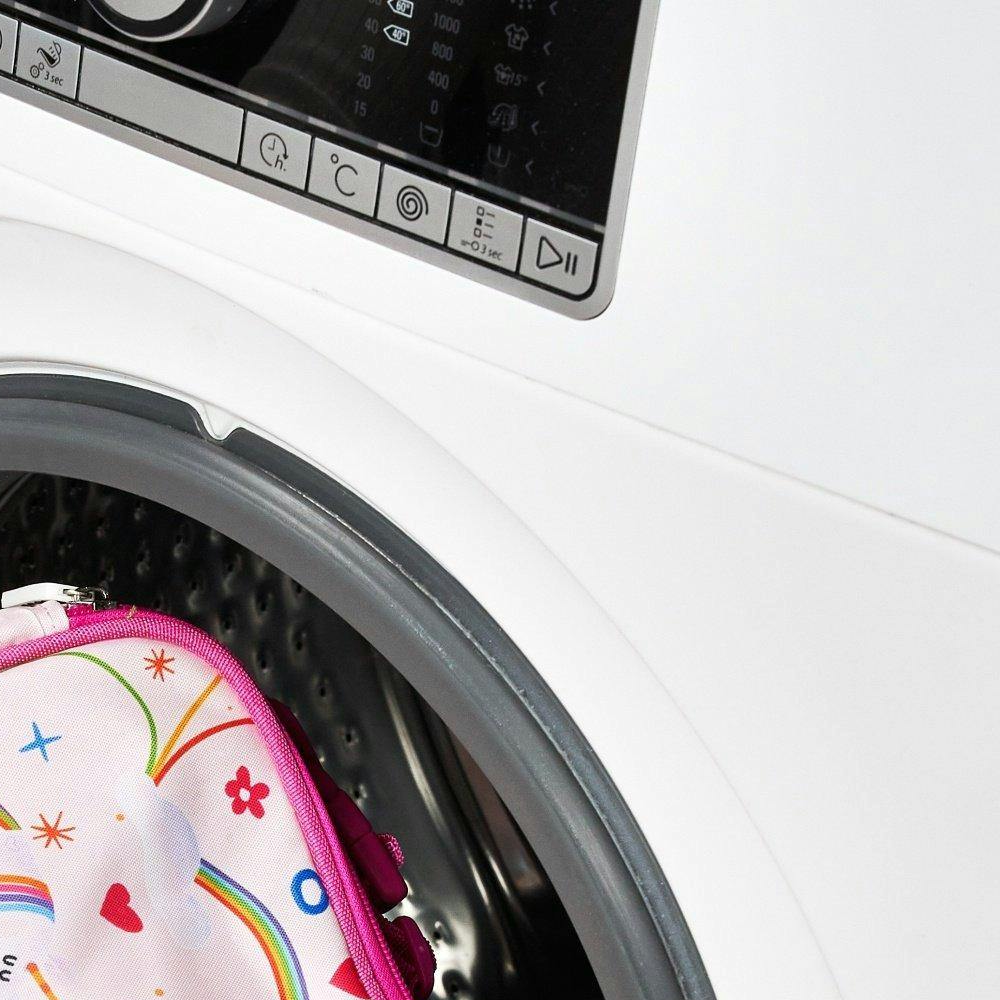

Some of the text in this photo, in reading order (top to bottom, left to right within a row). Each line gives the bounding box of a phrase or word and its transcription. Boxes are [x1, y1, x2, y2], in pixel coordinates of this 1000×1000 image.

[364, 17, 380, 34] 40
[433, 12, 460, 34] 1000
[360, 44, 375, 62] 30
[431, 41, 453, 62] 800
[44, 70, 64, 87] 3 sec
[356, 71, 372, 90] 20
[427, 70, 450, 90] 400
[354, 100, 367, 117] 15
